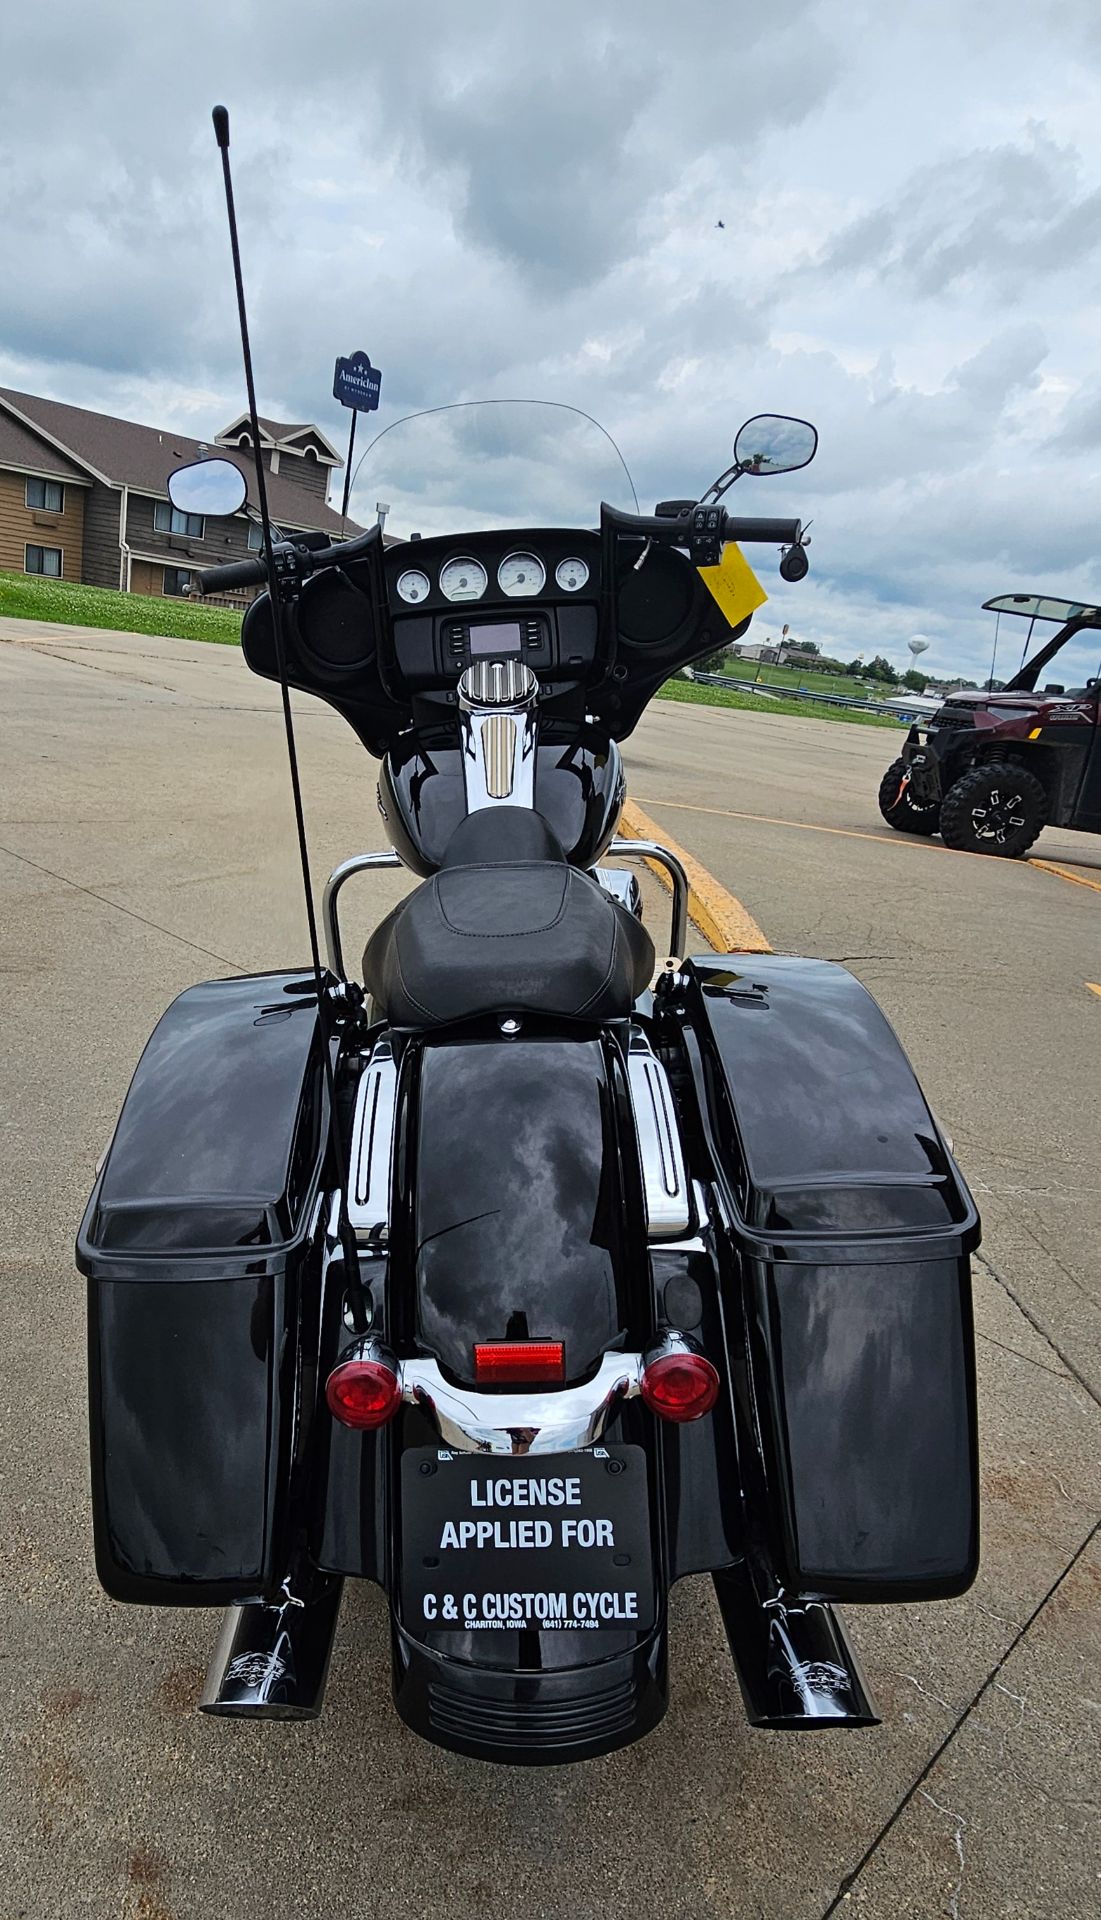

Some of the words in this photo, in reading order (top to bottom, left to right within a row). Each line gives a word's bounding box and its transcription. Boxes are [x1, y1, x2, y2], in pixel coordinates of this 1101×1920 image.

[470, 1478, 582, 1507] LICENSE
[439, 1521, 553, 1549] APPLIED
[561, 1519, 615, 1548] FOR
[423, 1593, 437, 1620] C
[441, 1593, 459, 1620] &
[462, 1593, 477, 1620] C
[482, 1592, 567, 1619] CUSTOM
[573, 1592, 639, 1619] CYCLE
[464, 1619, 506, 1630] CHARITON,
[506, 1619, 527, 1629] IOWA
[542, 1619, 562, 1629] (641)
[563, 1619, 600, 1629] 774-7494
